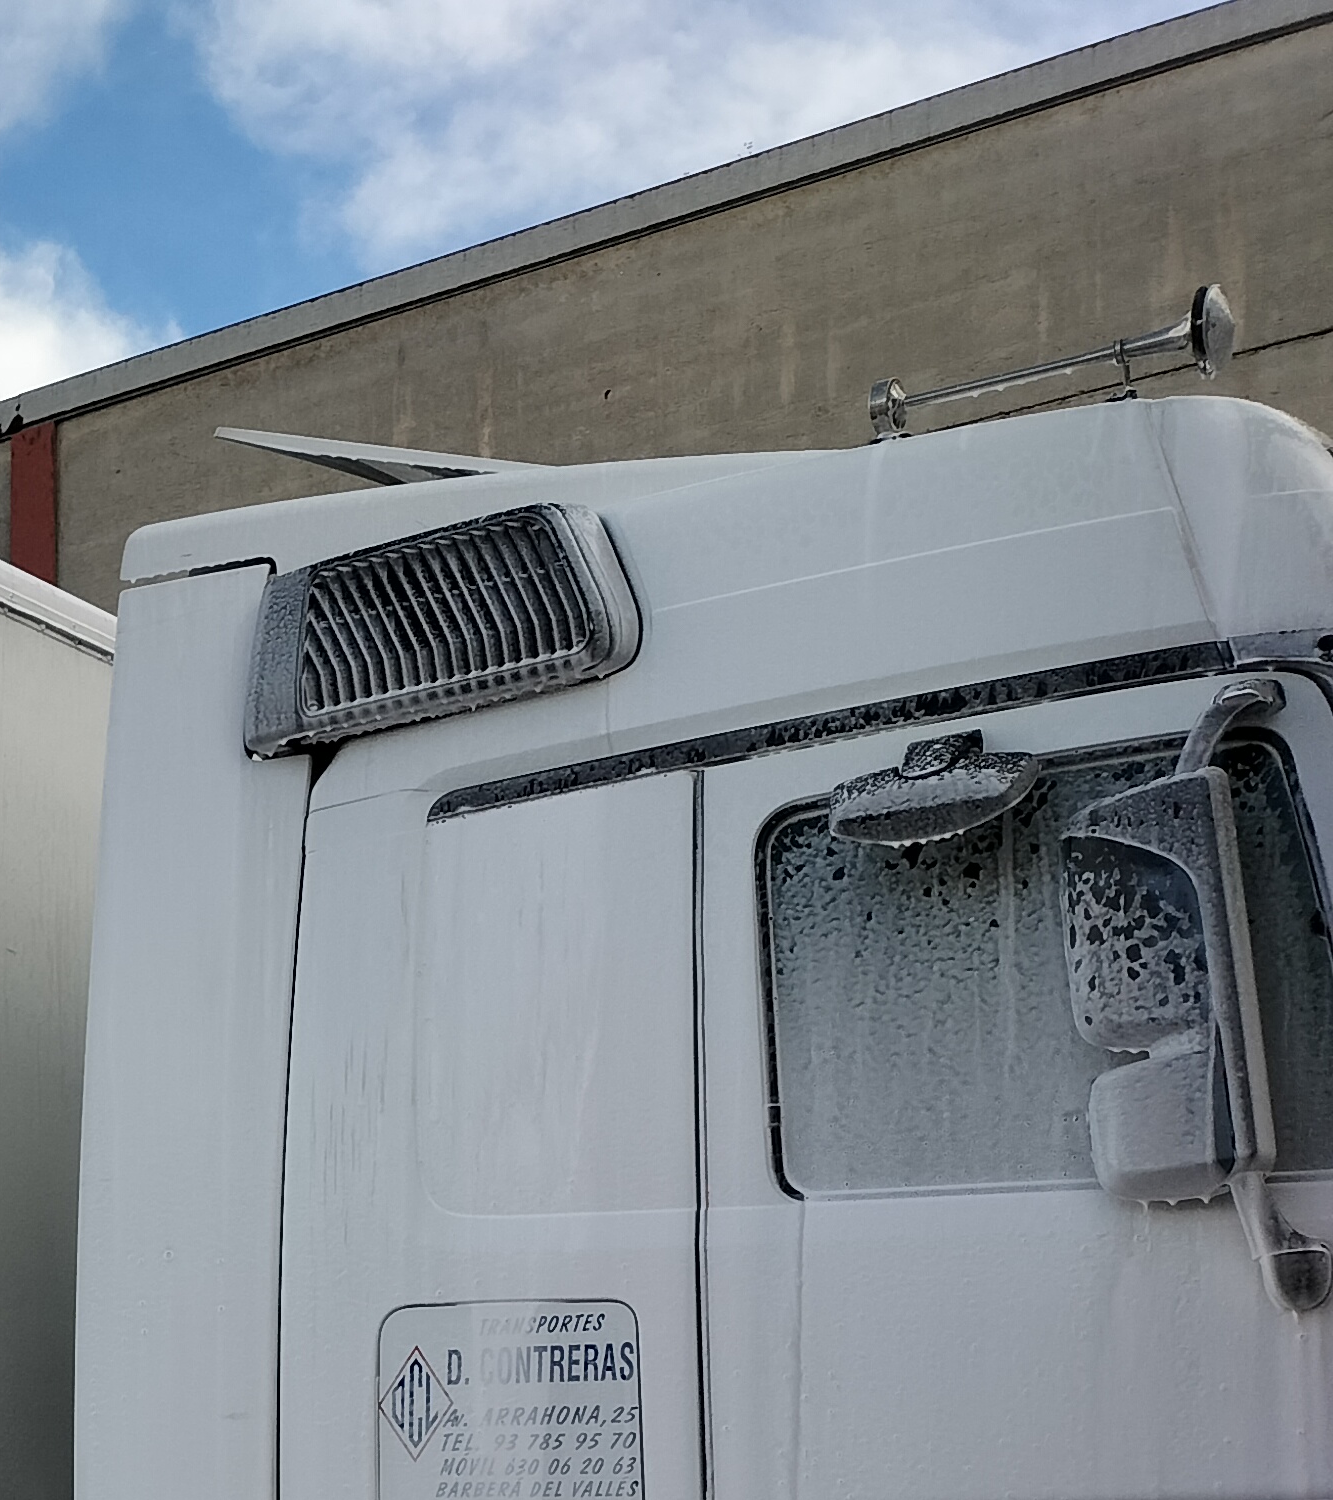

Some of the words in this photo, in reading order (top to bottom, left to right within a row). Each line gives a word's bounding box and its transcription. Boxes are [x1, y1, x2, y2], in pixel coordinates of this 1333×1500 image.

[479, 1313, 606, 1336] TRANSPORTES
[446, 1349, 470, 1385] D.
[480, 1341, 635, 1385] CONTRERAS
[494, 1433, 519, 1451] 93
[527, 1432, 566, 1451] 785
[575, 1432, 603, 1451] 95
[610, 1431, 637, 1450] 70
[548, 1457, 572, 1475] 06
[580, 1457, 605, 1475] 20
[613, 1456, 637, 1475] 63
[530, 1481, 563, 1498] DEL
